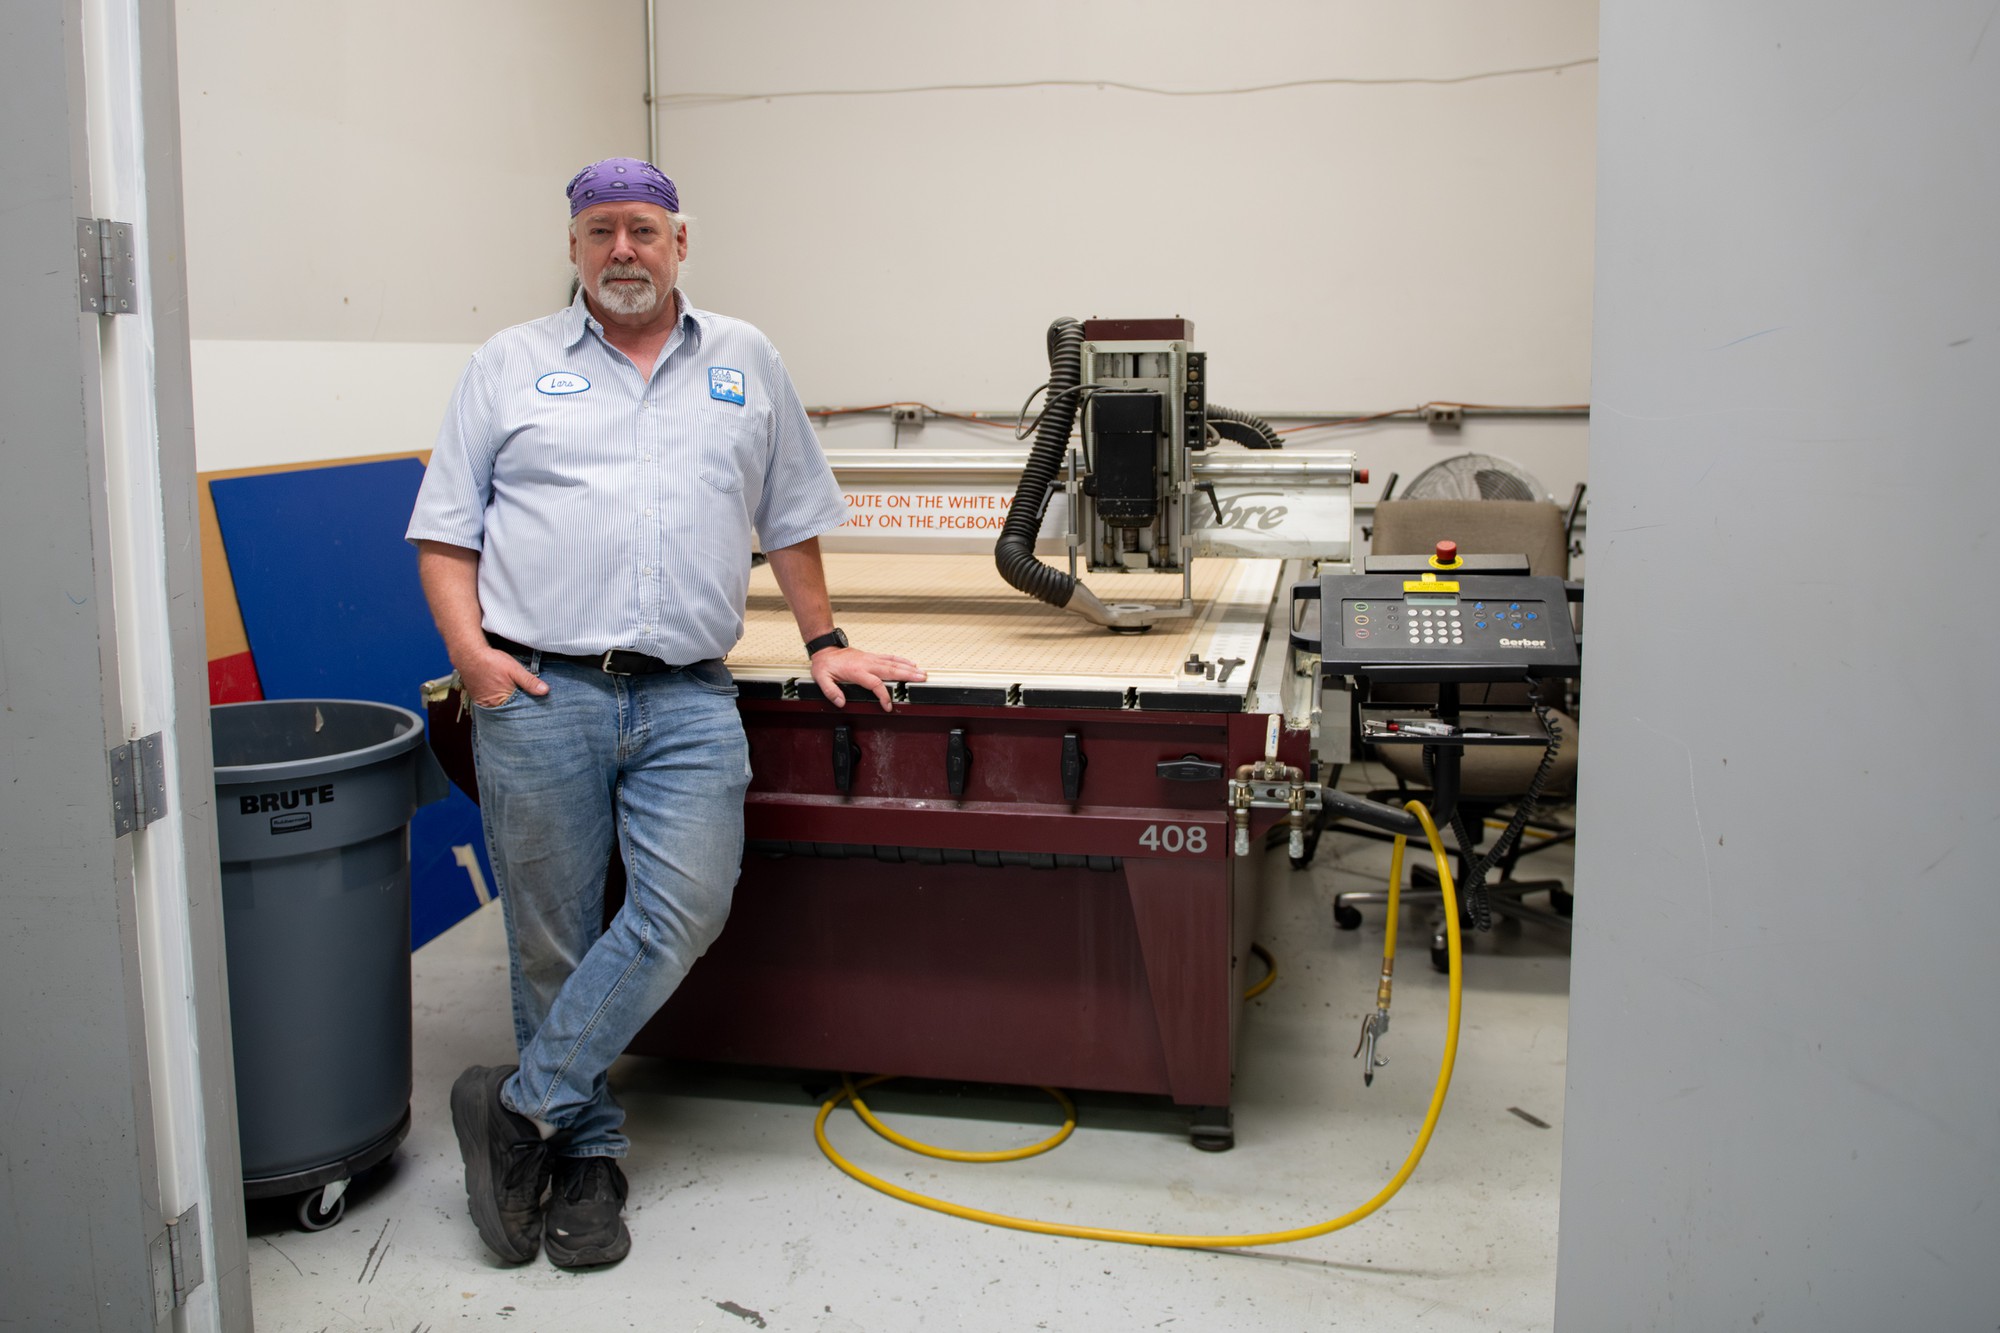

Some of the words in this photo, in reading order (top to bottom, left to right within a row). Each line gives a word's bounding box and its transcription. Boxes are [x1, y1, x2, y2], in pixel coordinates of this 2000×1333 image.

[551, 378, 574, 388] Lars
[887, 495, 910, 508] ON
[916, 495, 943, 508] THE
[948, 496, 995, 509] WHITE
[879, 514, 902, 528] ON
[907, 515, 934, 528] THE
[1499, 638, 1546, 647] Gerber
[240, 784, 335, 815] BRUTE
[1138, 824, 1208, 853] 408
